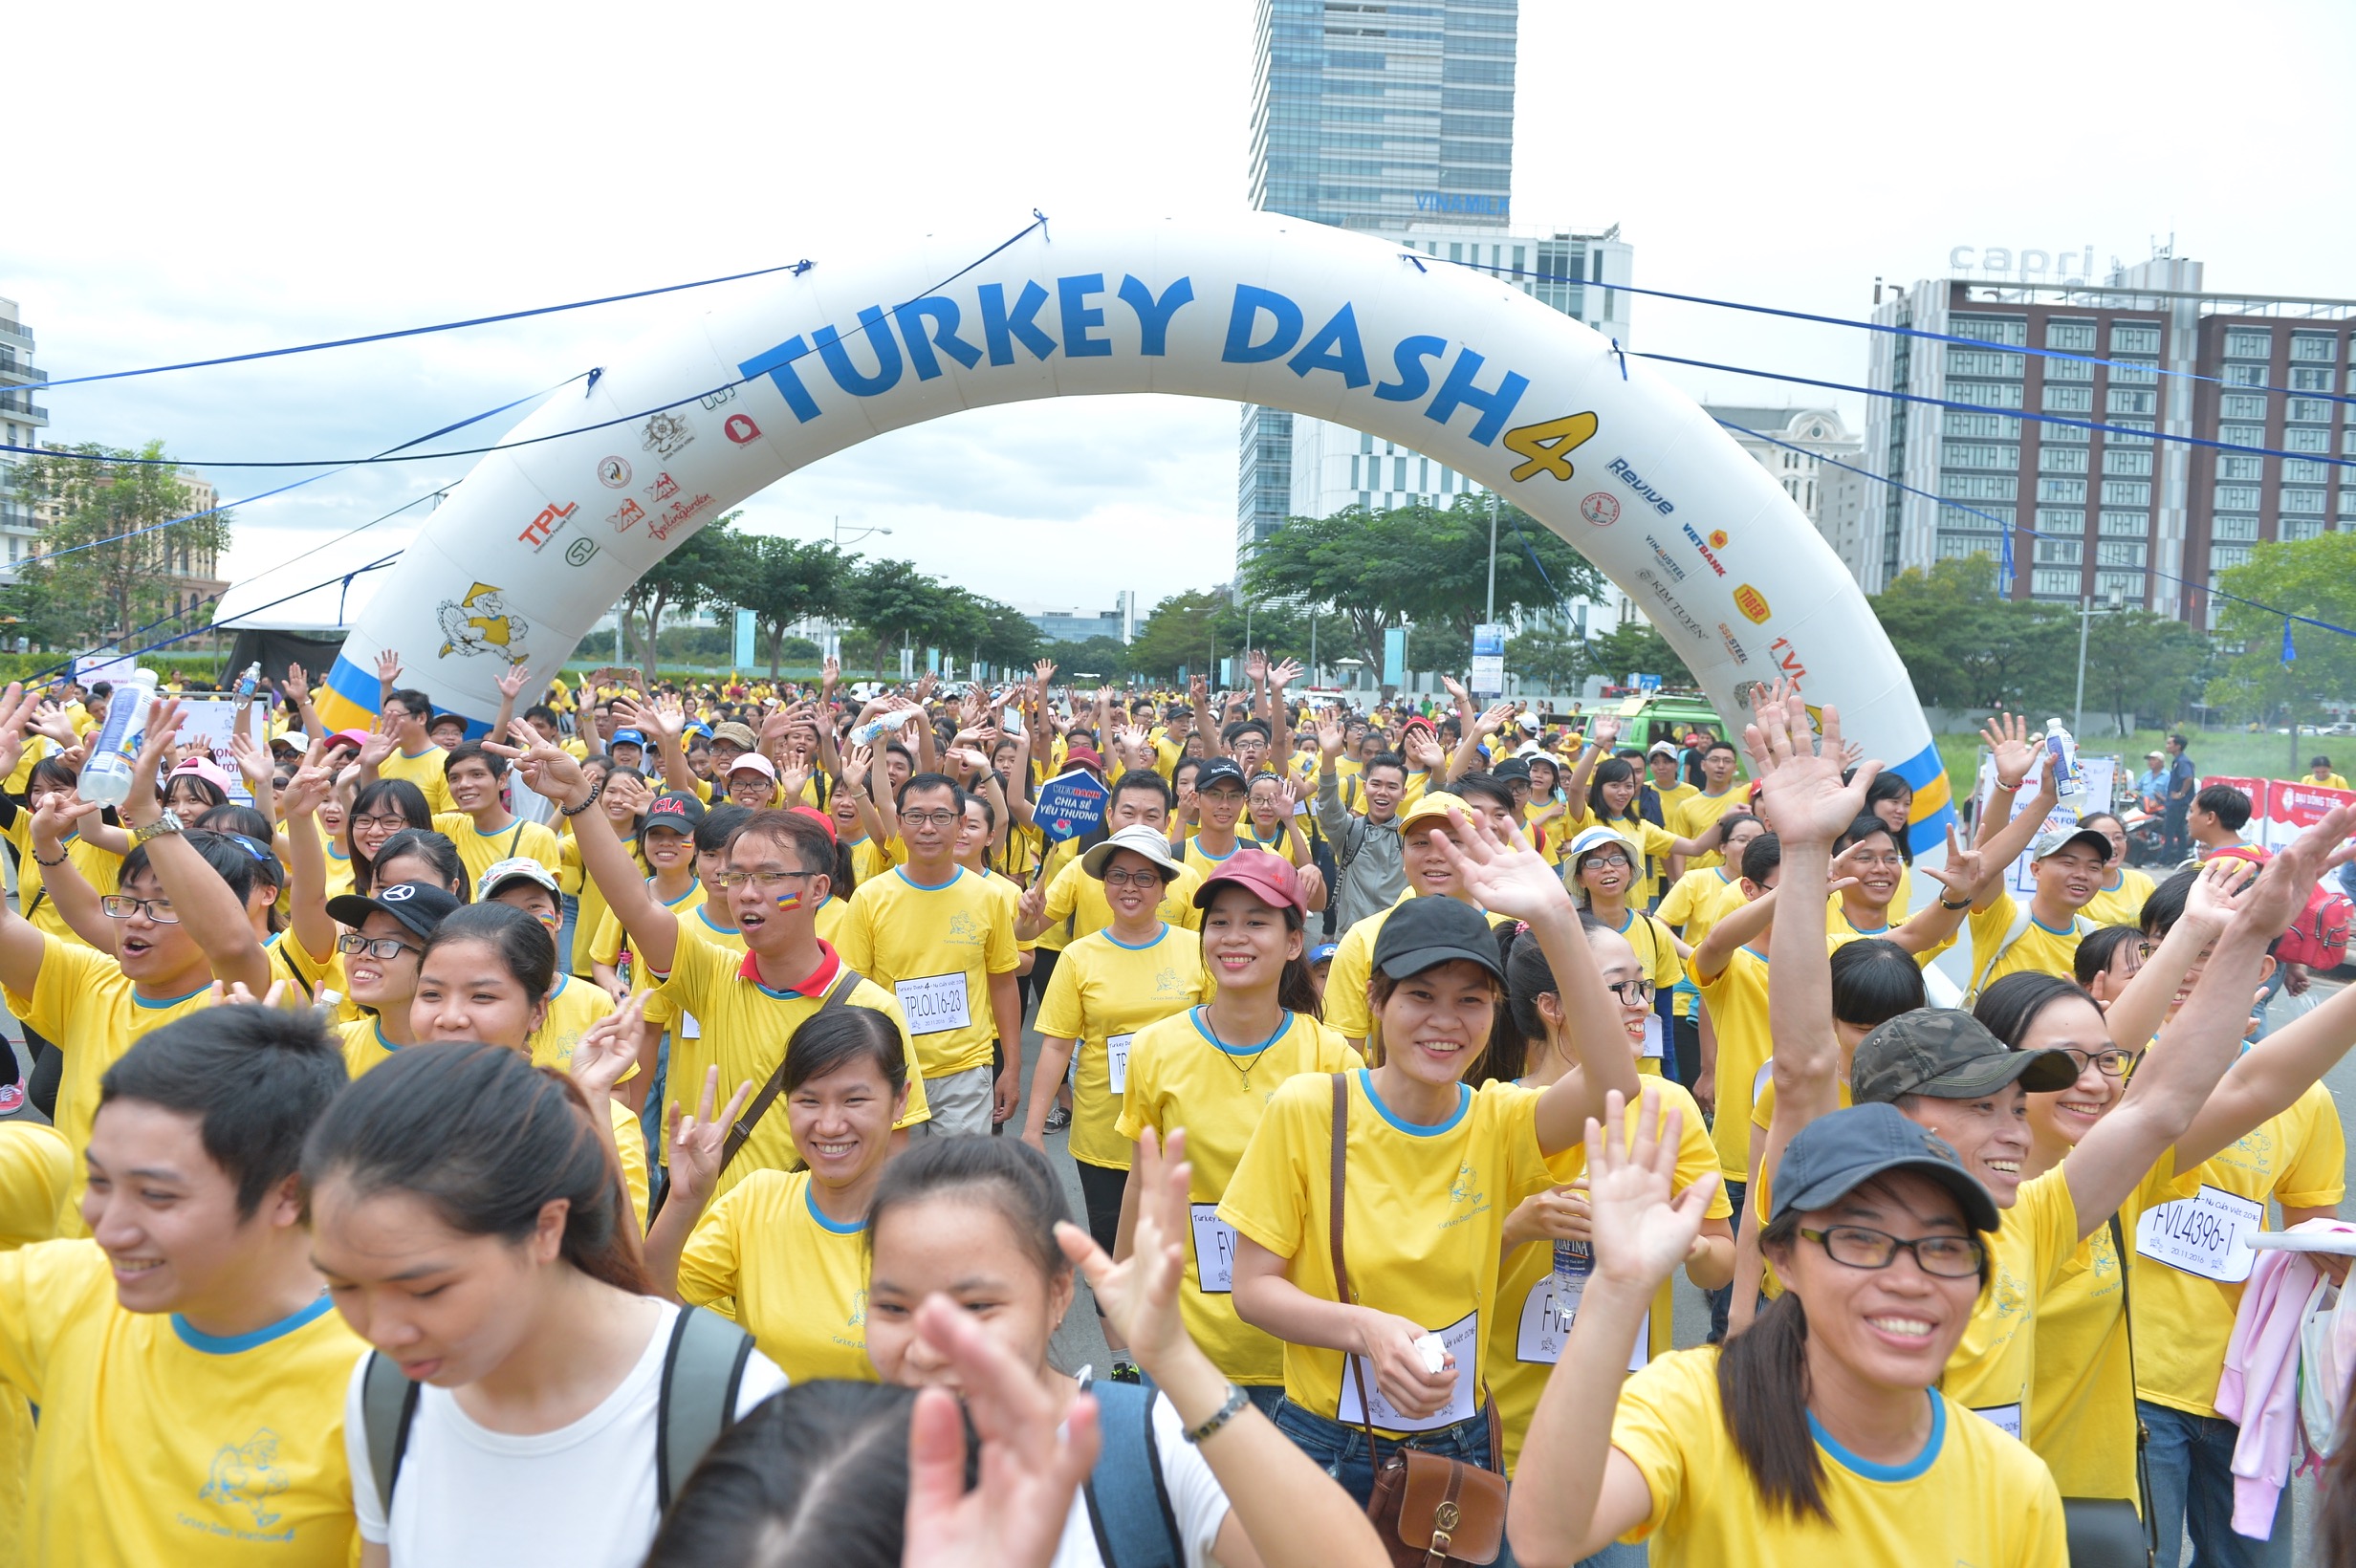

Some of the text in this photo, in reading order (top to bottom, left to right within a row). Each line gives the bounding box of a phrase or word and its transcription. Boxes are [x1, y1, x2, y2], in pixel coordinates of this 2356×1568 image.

[1949, 245, 2094, 283] capri
[736, 272, 1599, 483] TURKEY DASH 4
[517, 501, 576, 546] TPL
[553, 520, 567, 534] People
[565, 504, 579, 520] Limited
[1683, 523, 1727, 577] VIETBANK
[1651, 580, 1673, 602] KIM
[1739, 589, 1766, 619] TIGER
[1053, 783, 1102, 799] VIETBANK
[651, 797, 686, 817] CIA
[1040, 804, 1099, 821] YÊU THƯƠNG
[1055, 795, 1078, 809] CHIA
[924, 982, 930, 991] 4
[905, 990, 961, 1018] TPLOL16-23
[1193, 1214, 1216, 1223] Turkey
[2243, 1211, 2259, 1222] 2016
[2153, 1201, 2236, 1256] FVL4396-1
[2171, 1247, 2204, 1264] 20.11.2016
[832, 1336, 856, 1348] Turkey
